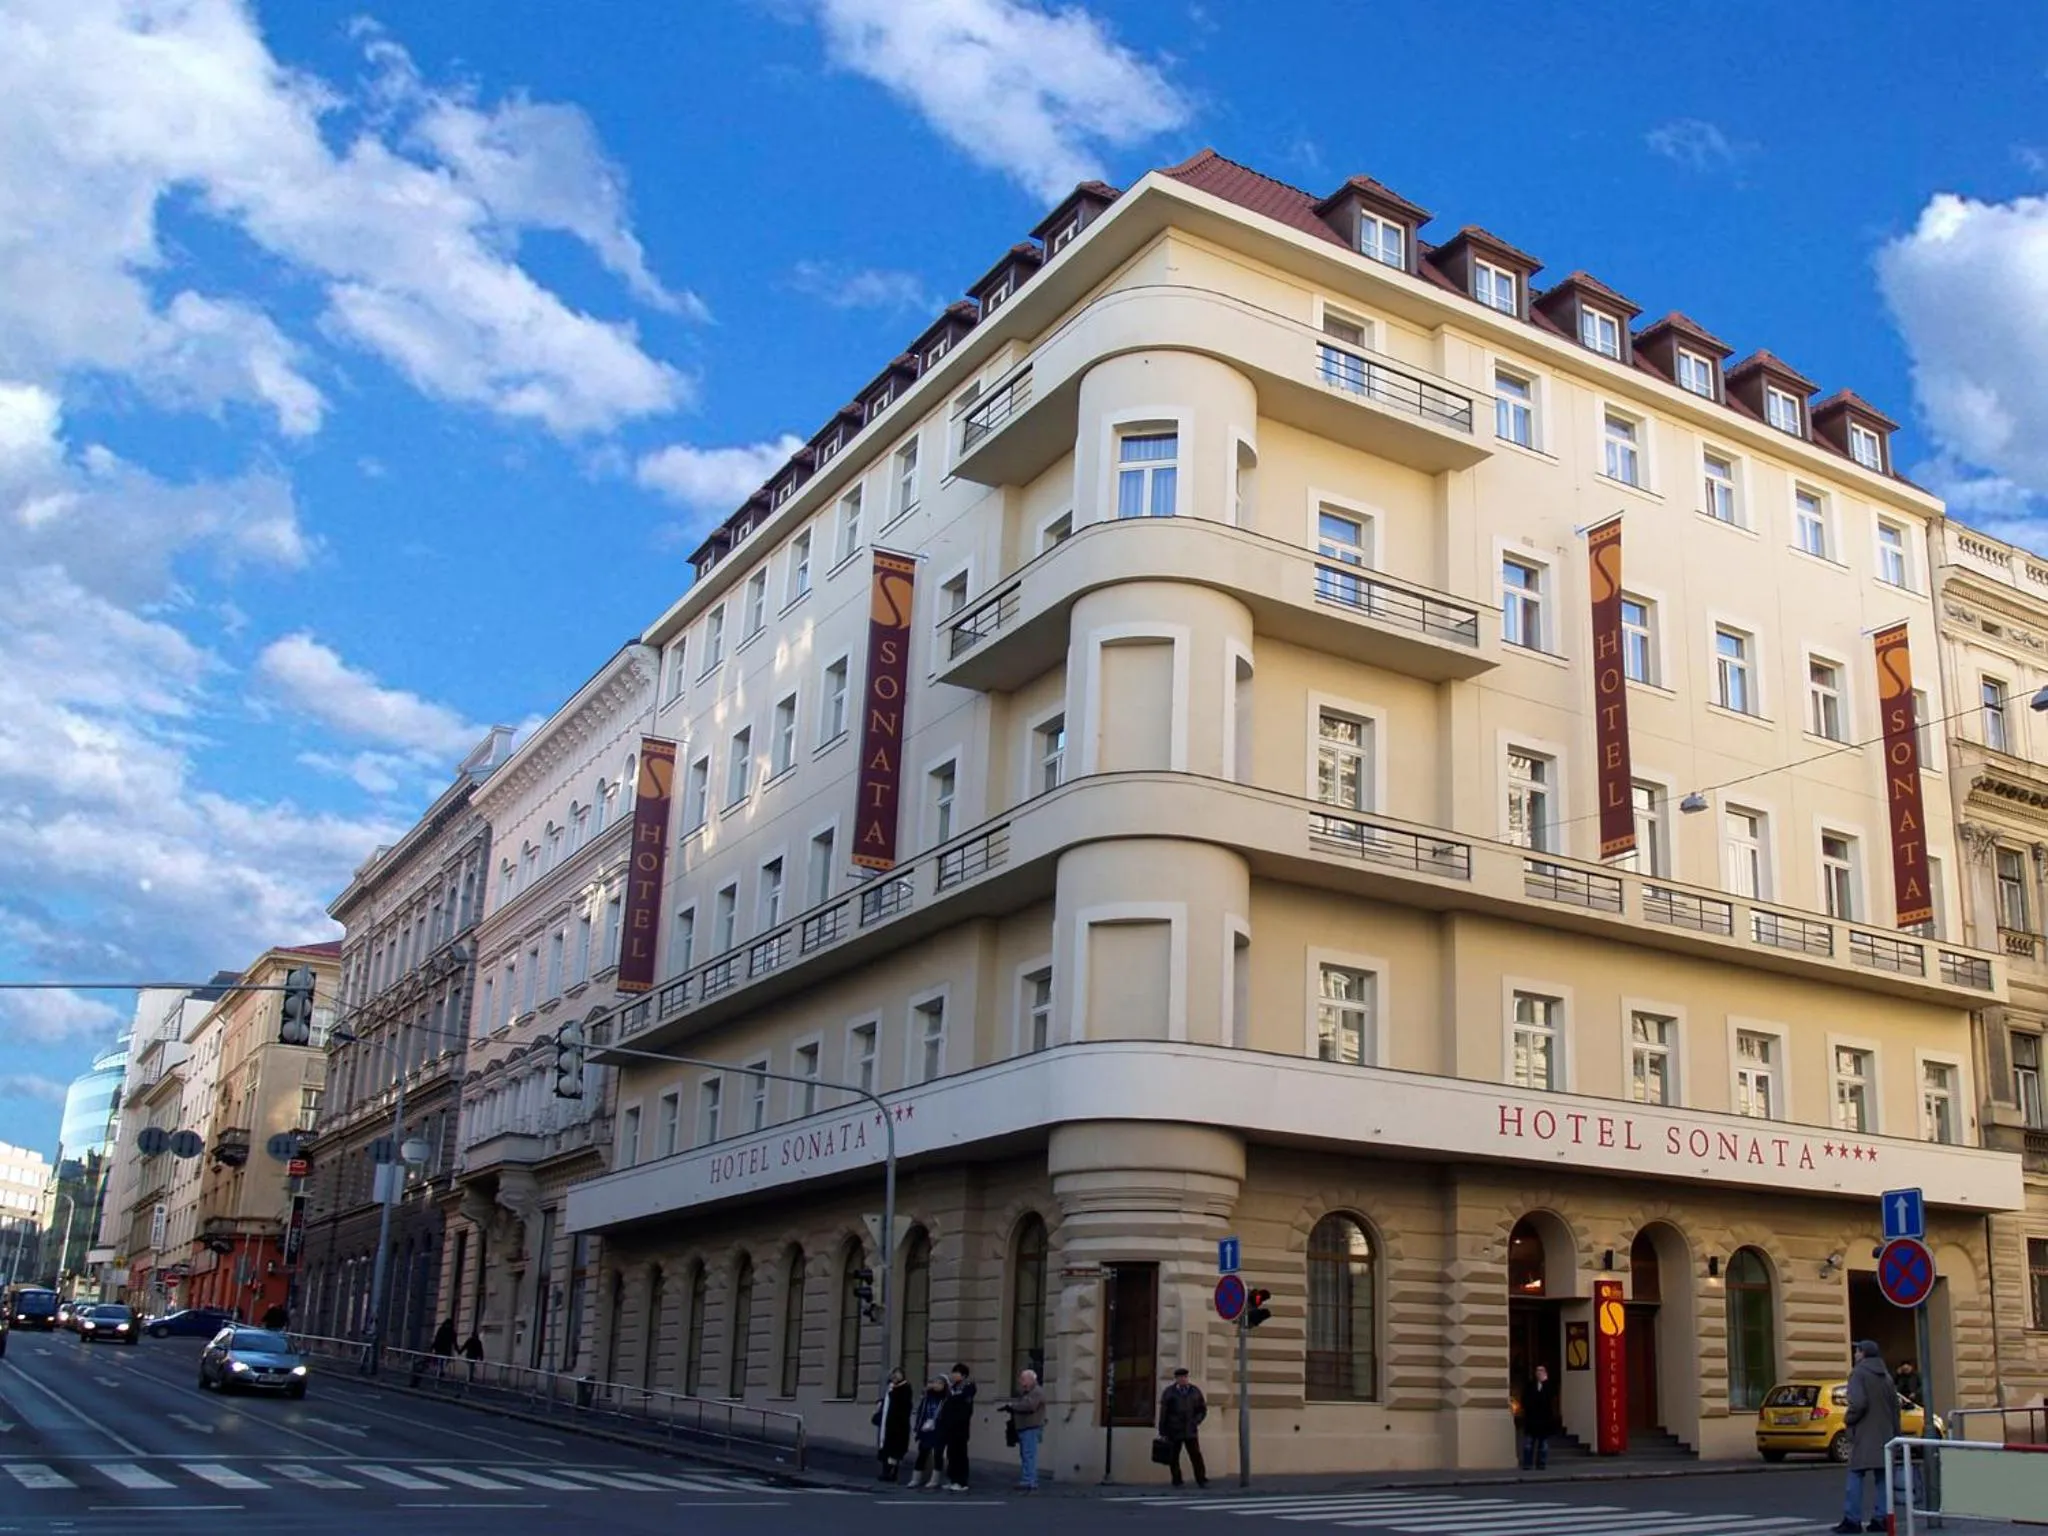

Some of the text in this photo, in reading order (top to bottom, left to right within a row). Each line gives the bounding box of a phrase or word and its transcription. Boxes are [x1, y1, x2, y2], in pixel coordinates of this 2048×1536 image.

[863, 640, 898, 846] SONATA
[1597, 629, 1625, 808] HOTEL
[1890, 708, 1923, 901] SONATA
[631, 822, 662, 959] HOTEL
[709, 1120, 867, 1184] HOTEL SONATA
[1498, 1104, 1815, 1171] HOTEL SONATA
[1608, 1337, 1620, 1446] RECEPTION
